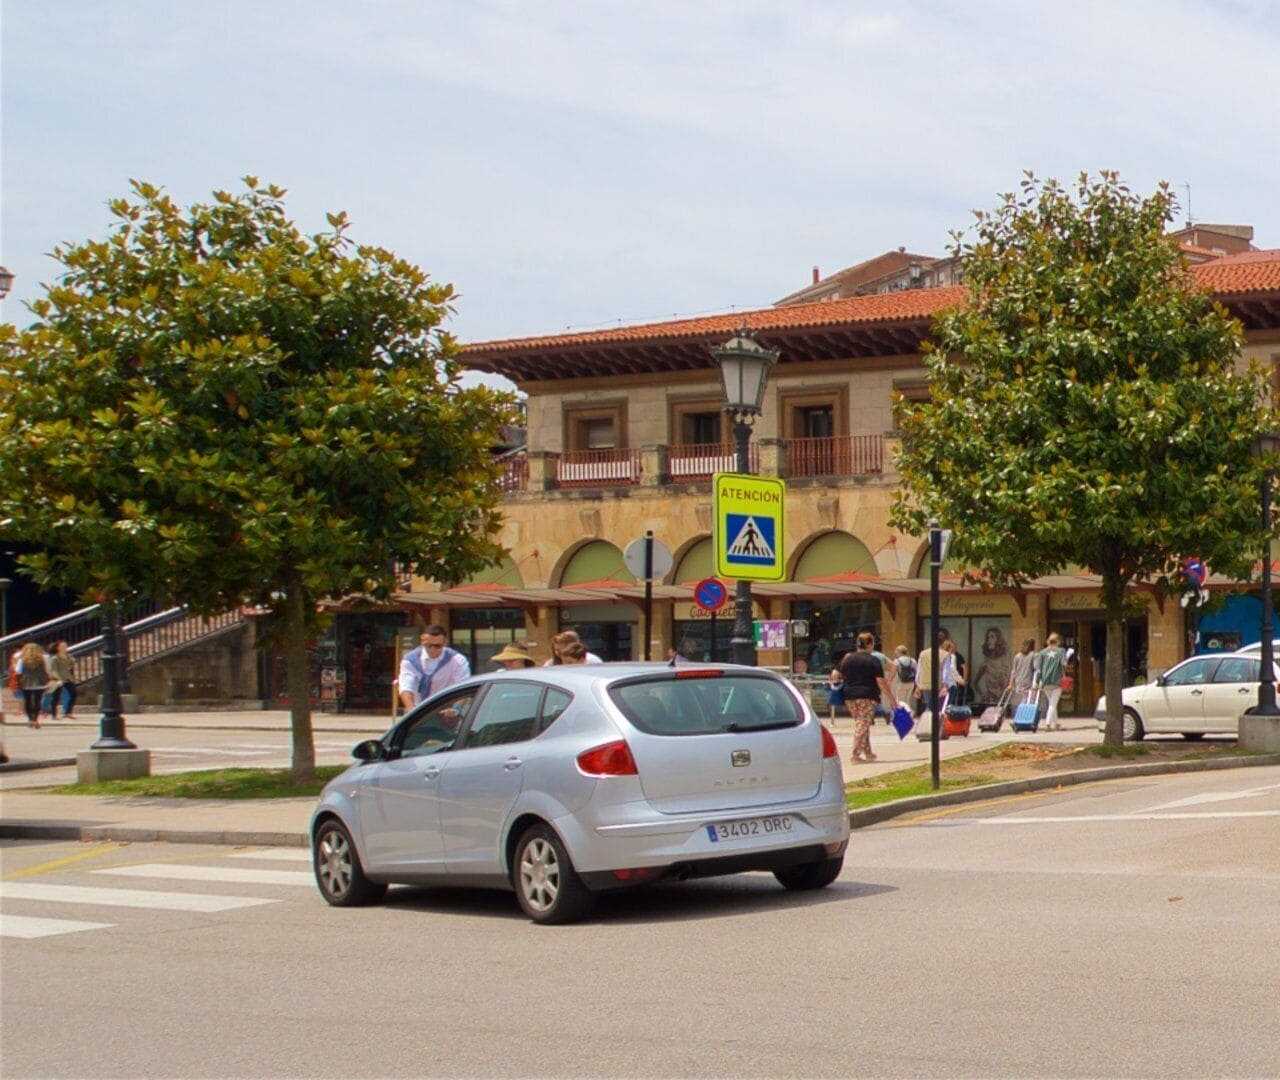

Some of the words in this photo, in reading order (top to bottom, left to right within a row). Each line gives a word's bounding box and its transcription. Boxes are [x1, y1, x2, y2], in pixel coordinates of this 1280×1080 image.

[721, 487, 780, 503] ATENCIÓN
[719, 822, 760, 839] 3402
[763, 817, 793, 833] DRC
